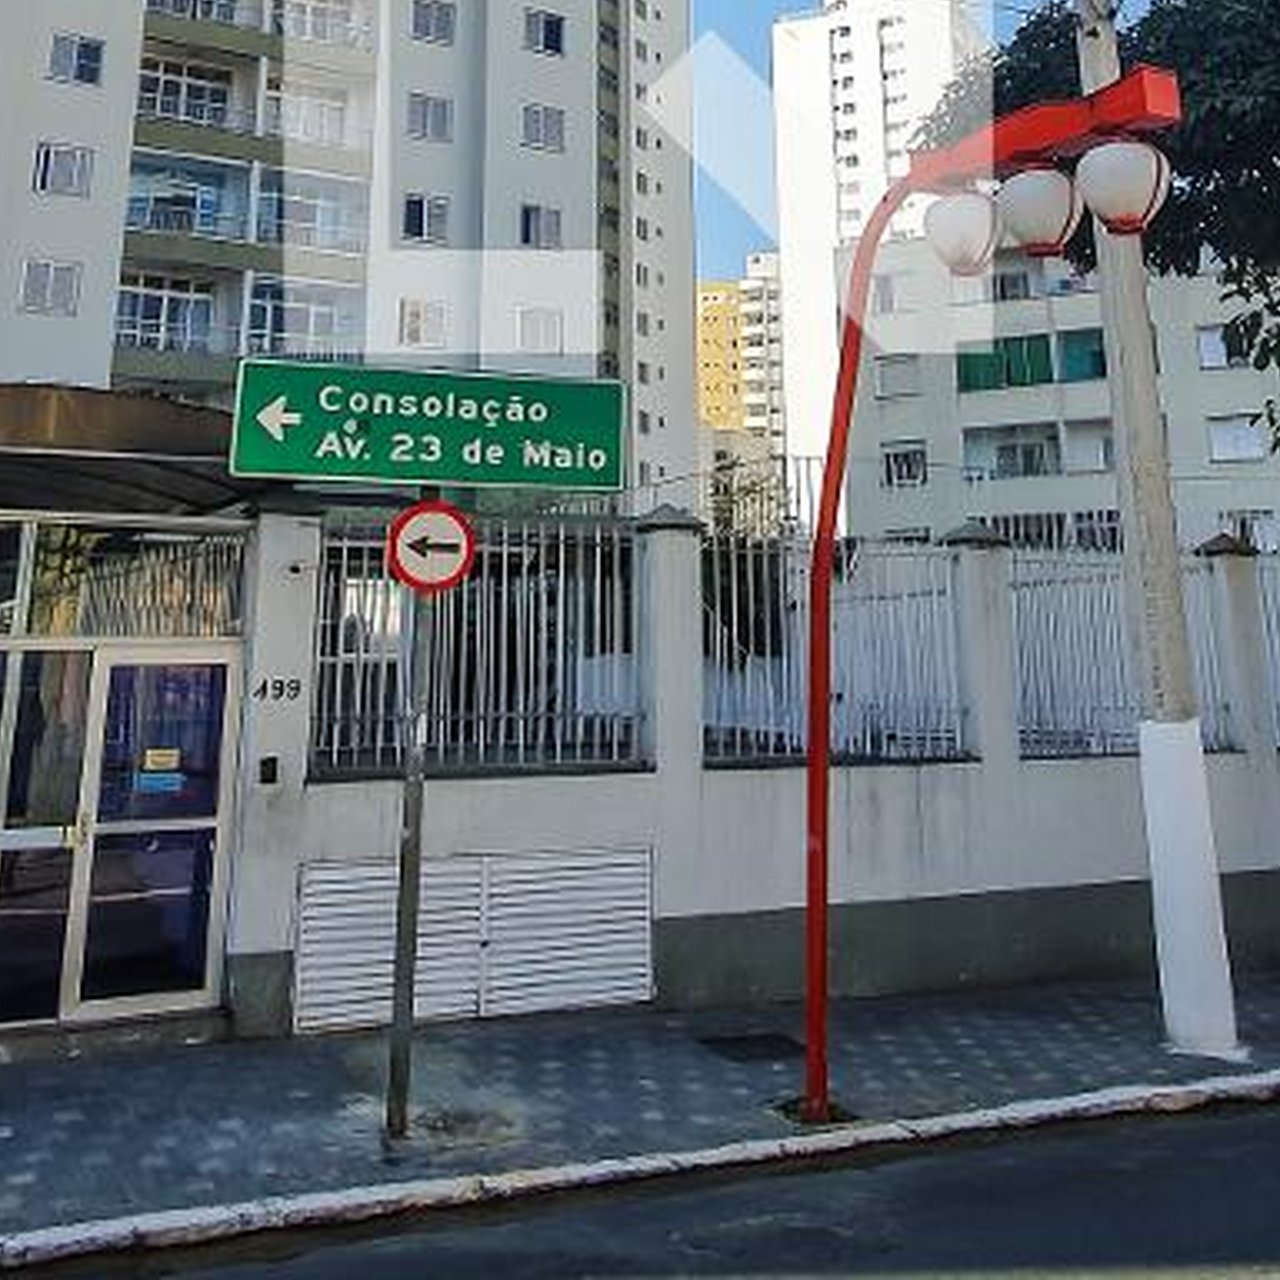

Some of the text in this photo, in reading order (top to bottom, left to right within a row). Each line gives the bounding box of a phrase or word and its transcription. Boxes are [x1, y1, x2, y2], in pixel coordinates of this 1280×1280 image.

[319, 385, 548, 428] Consolação
[314, 431, 607, 471] Av. 23 de Maio
